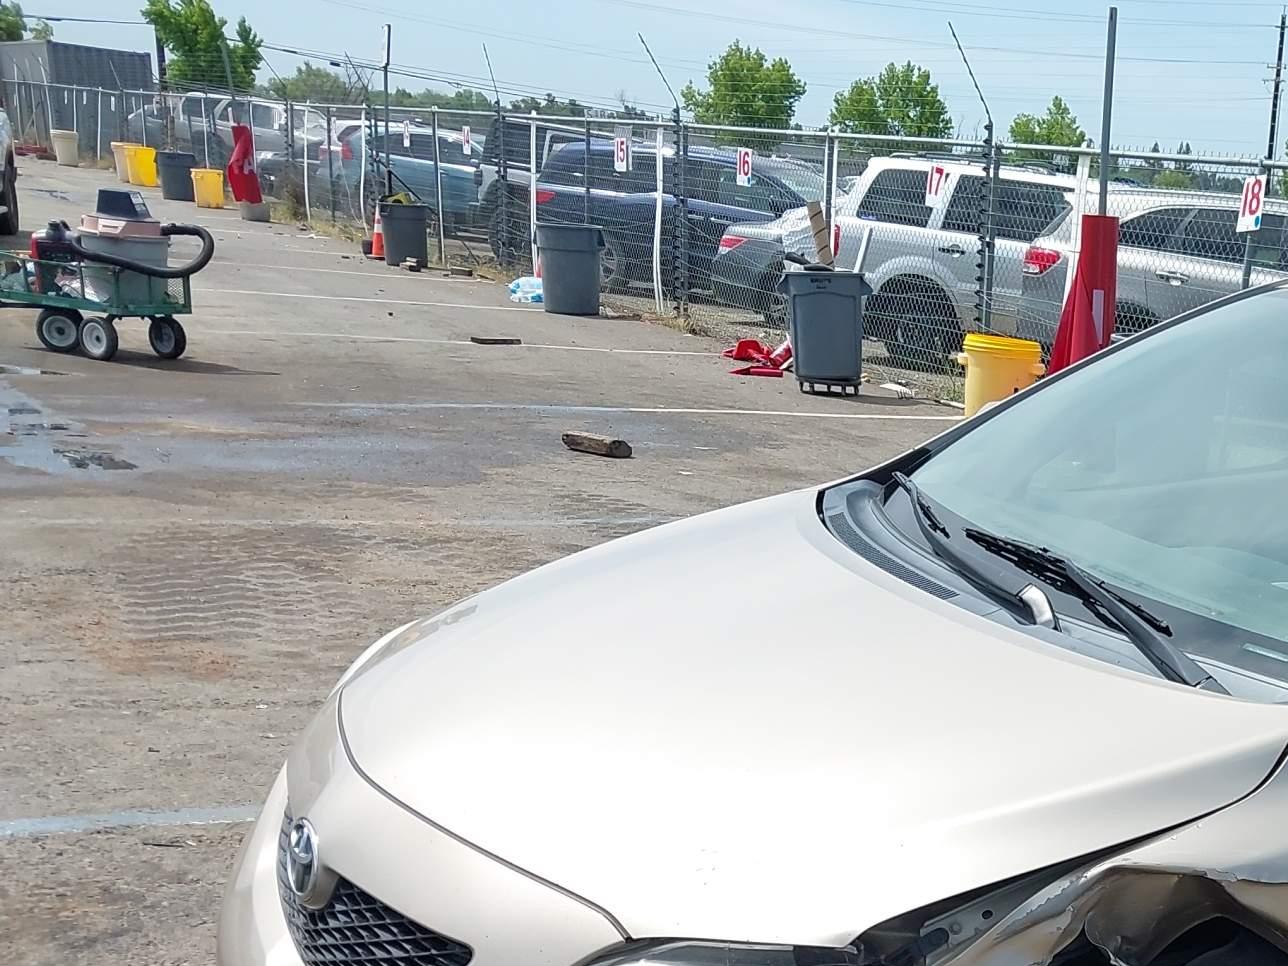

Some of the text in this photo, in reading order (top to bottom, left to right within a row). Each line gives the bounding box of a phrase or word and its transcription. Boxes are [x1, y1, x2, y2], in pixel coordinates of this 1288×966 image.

[616, 140, 625, 163] 15
[738, 151, 750, 177] 16
[928, 165, 944, 196] 17
[1241, 179, 1262, 218] 18
